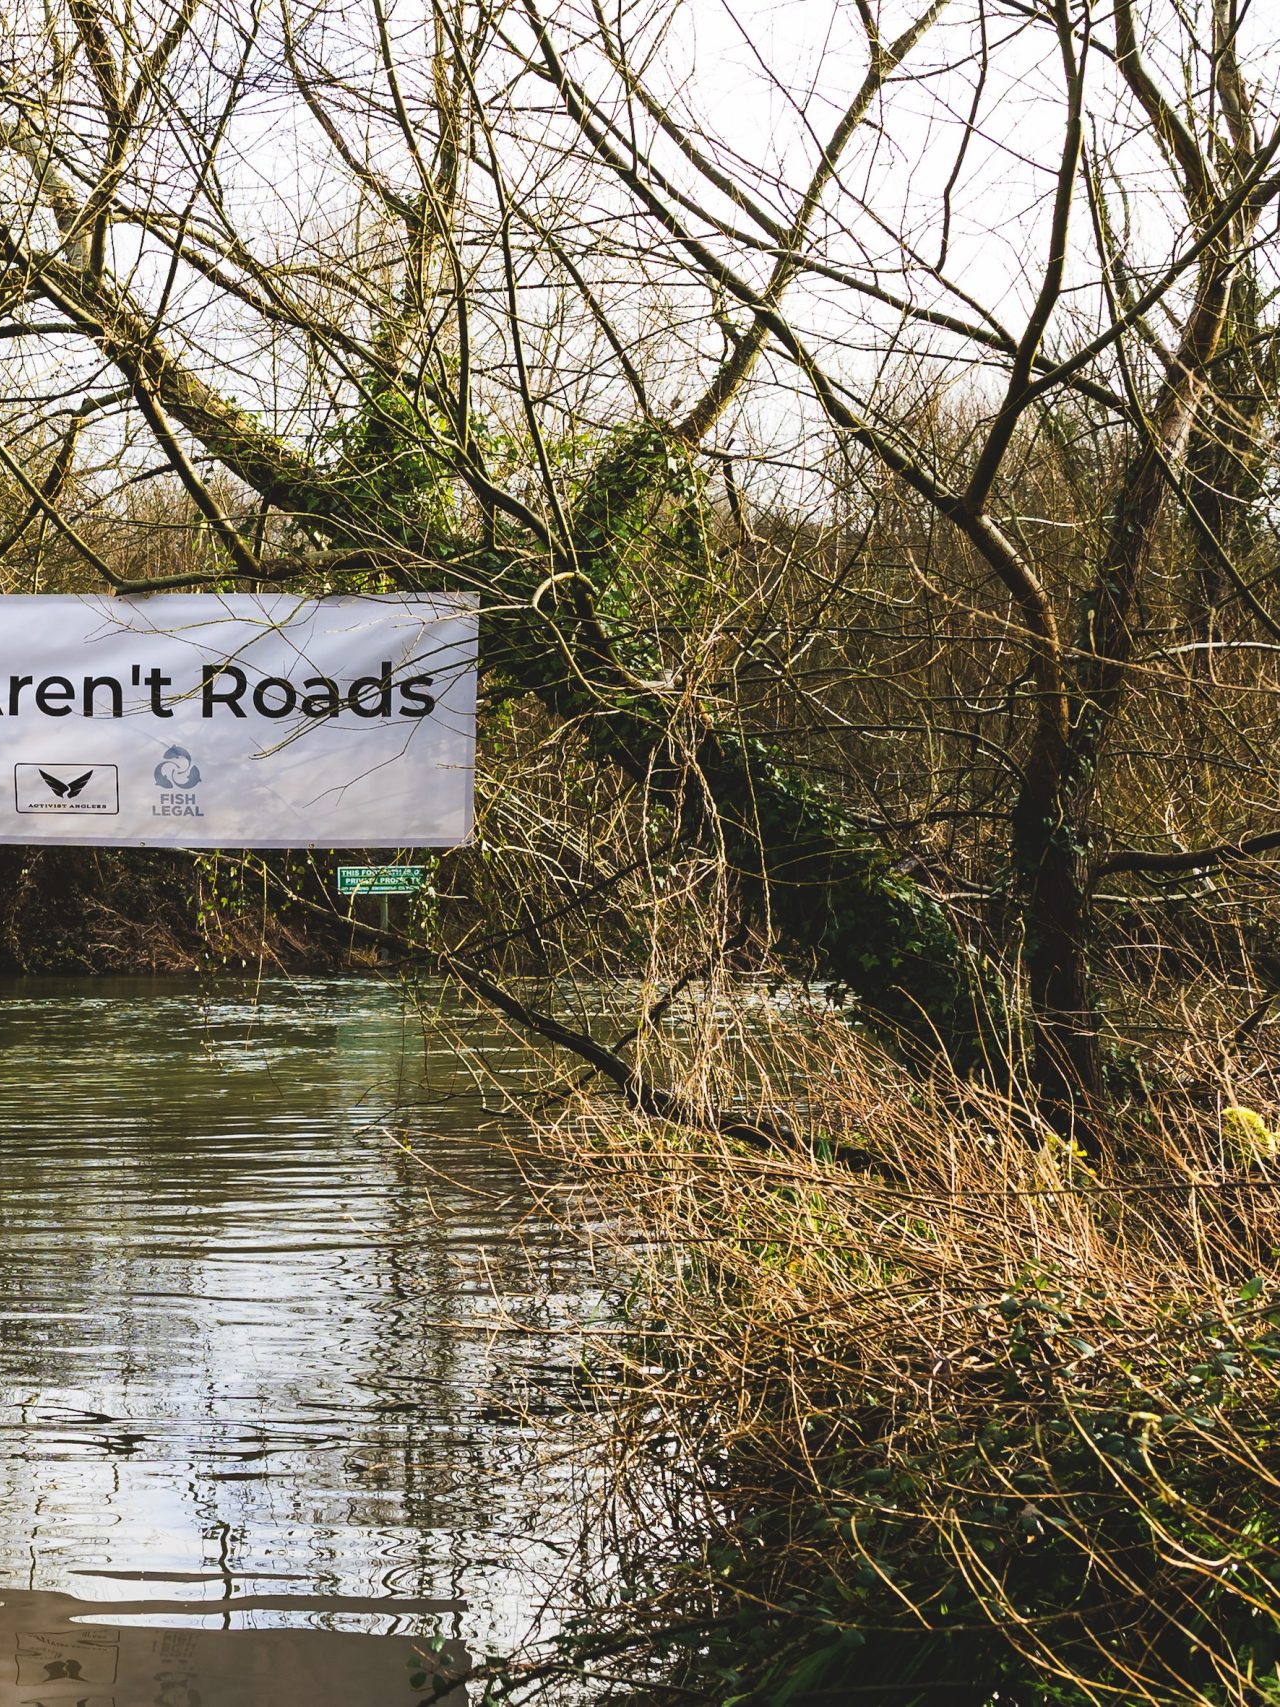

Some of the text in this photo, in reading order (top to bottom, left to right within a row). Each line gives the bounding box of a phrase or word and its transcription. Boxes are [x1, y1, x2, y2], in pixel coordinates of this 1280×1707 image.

[202, 661, 435, 719] Roads
[160, 793, 196, 805] FISH
[152, 805, 205, 817] LEGAL
